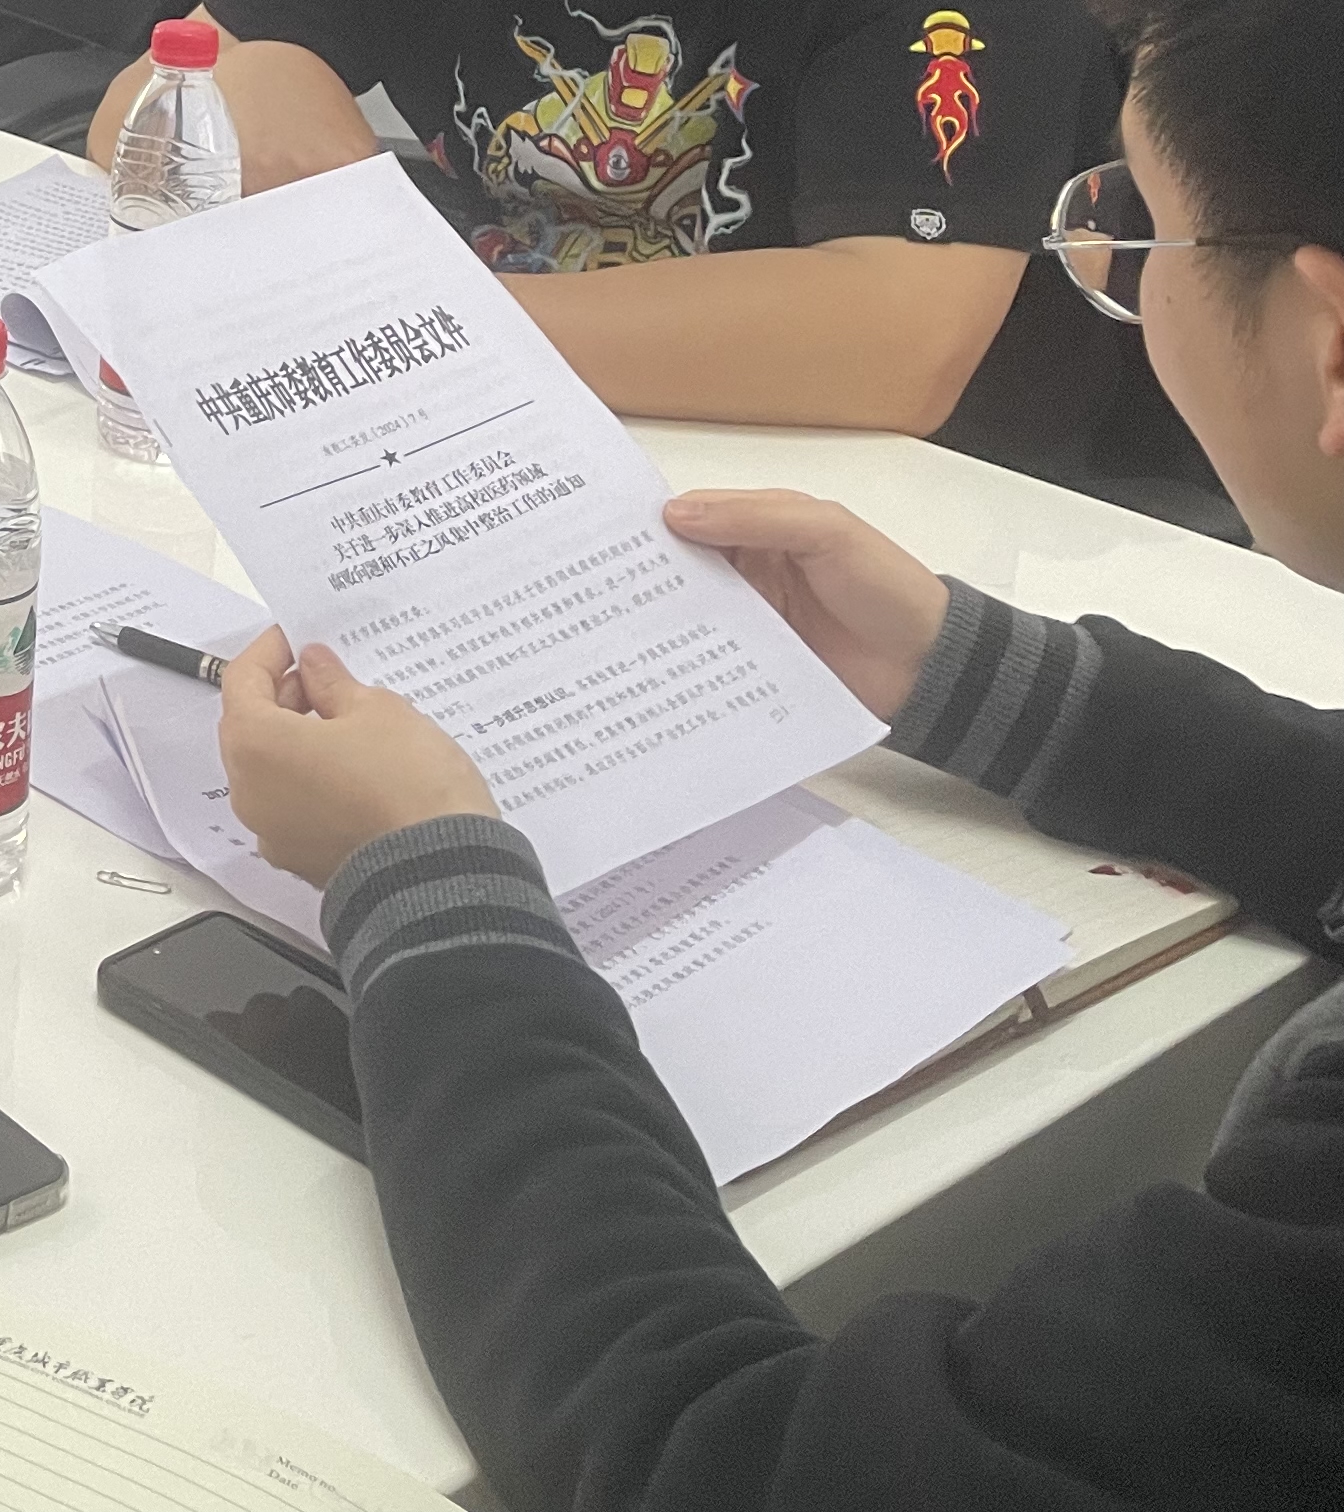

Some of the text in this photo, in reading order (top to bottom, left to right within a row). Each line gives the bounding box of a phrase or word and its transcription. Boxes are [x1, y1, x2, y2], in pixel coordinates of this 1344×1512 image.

[188, 304, 478, 436] 中共重庆市委教育工作委员会文件
[327, 473, 586, 592] 腐败问题和不正之风集中整治工作的通知
[330, 450, 517, 534] 中共重庆市委教育工作委员会
[333, 463, 549, 564] 关于进一步深入推进高校医药领域
[267, 1469, 298, 1490] Date
[276, 1456, 317, 1482] Memo
